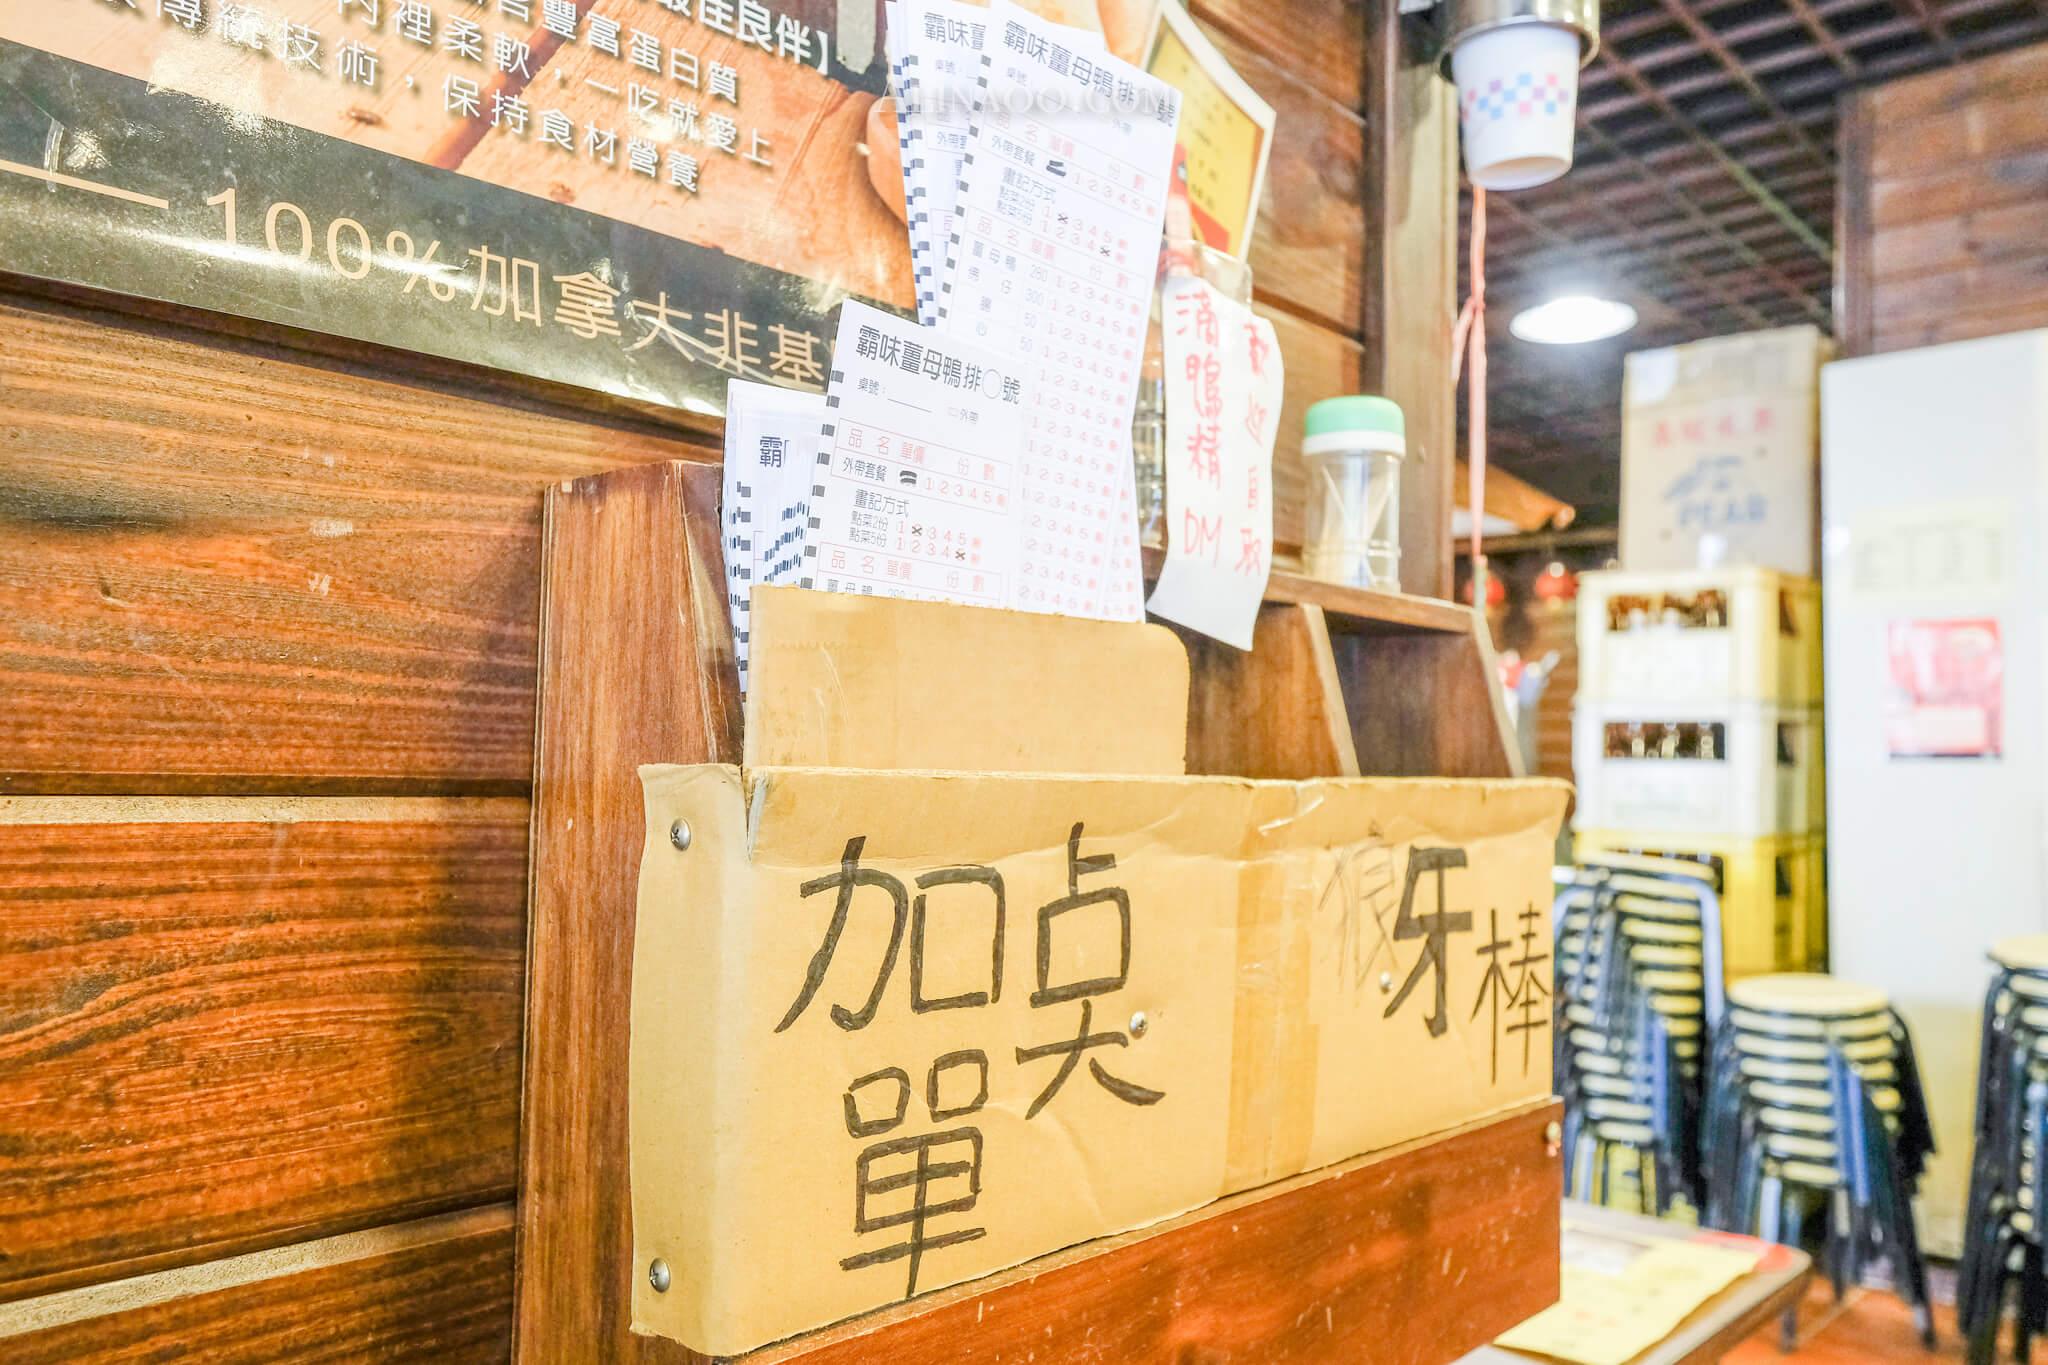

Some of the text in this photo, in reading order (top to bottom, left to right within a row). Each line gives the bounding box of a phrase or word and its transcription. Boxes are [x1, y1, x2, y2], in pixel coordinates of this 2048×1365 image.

[124, 0, 699, 192] 傳統技術，保持食材營養
[206, 187, 838, 386] 100%加拿大非基
[759, 435, 790, 468] 霸
[1184, 507, 1223, 568] DM
